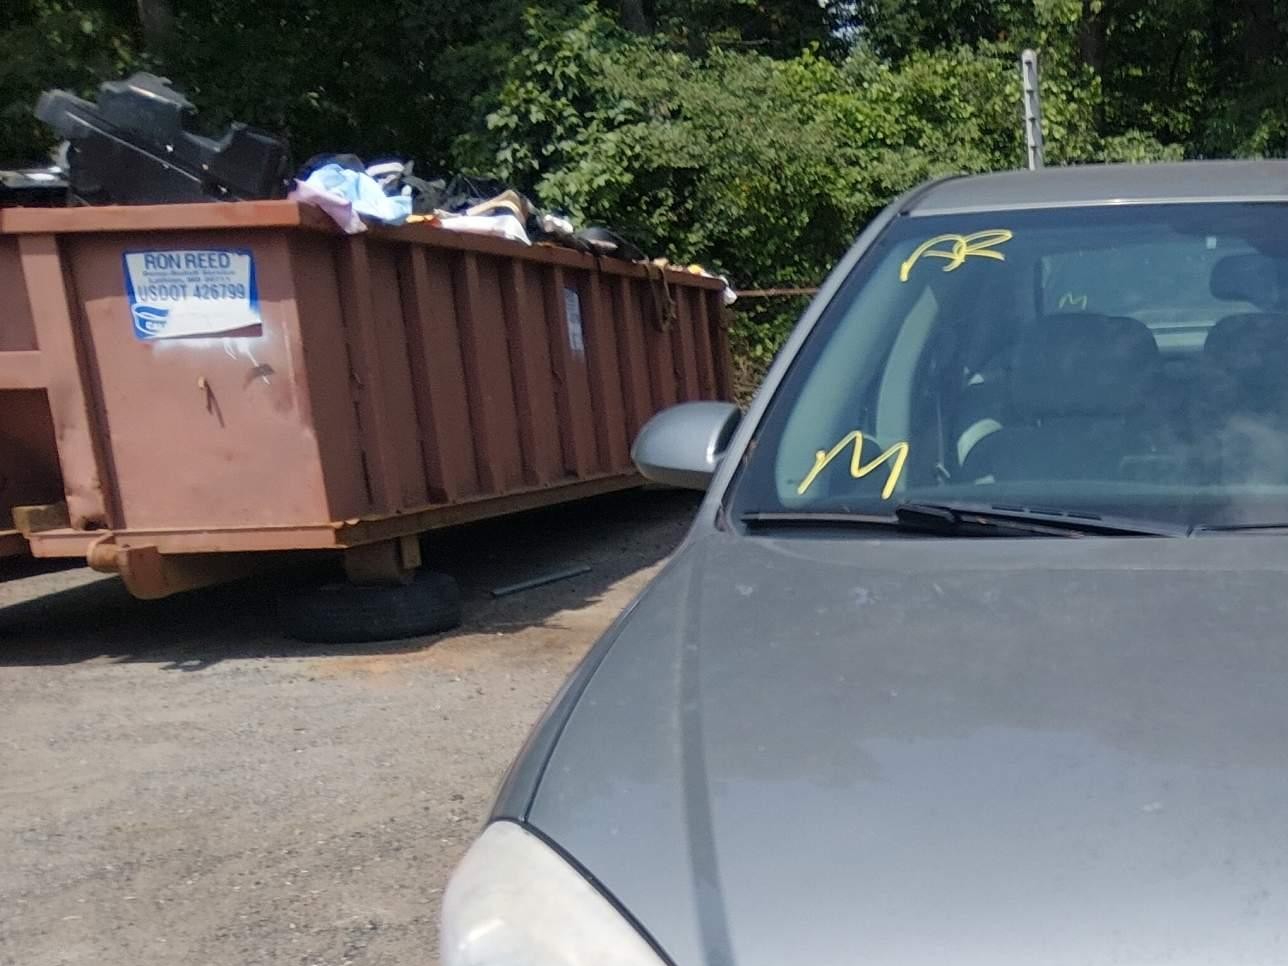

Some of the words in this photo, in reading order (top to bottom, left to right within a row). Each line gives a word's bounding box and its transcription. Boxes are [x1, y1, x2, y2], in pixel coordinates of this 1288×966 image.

[144, 253, 181, 270] RON
[184, 252, 231, 269] REED
[137, 284, 188, 301] USDOT
[193, 284, 246, 300] 426799
[797, 430, 909, 499] M
